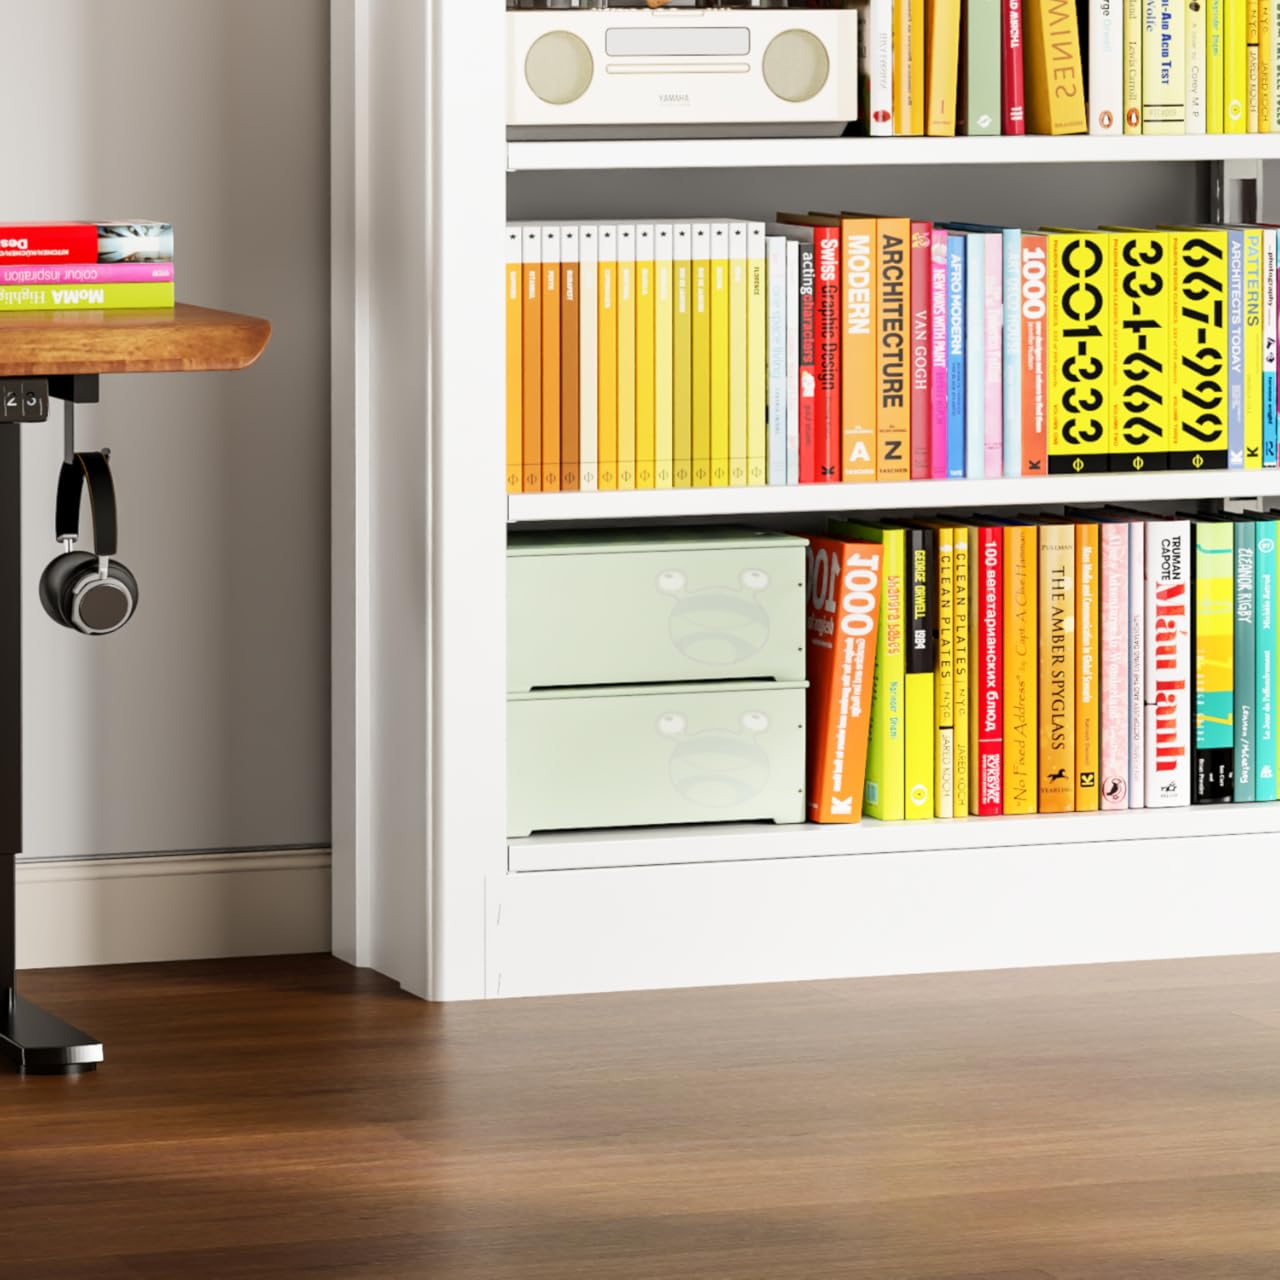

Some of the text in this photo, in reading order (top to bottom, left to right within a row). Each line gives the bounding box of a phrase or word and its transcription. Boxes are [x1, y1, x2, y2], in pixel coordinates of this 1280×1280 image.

[1128, 41, 1137, 101] Lewis Carroll
[1161, 33, 1172, 58] ACID
[1161, 61, 1172, 85] TEST
[658, 94, 690, 103] YAMAHA
[4, 268, 99, 283] colour inspiration
[51, 289, 105, 304] MoMA
[818, 238, 837, 390] Swiss Graphic Design
[848, 234, 870, 334] MODERN
[882, 234, 903, 408] ARCHITECTURE
[932, 269, 945, 368] NEW WAYS WITH PAINT
[951, 254, 961, 355] AFRO MODERN
[1023, 247, 1045, 319] 1000
[1231, 240, 1241, 373] ARCHITECTS TODAY
[1247, 235, 1259, 326] PATTERNS
[915, 310, 927, 390] VAN GOGH
[1123, 239, 1164, 446] 334-666
[1182, 238, 1223, 443] 667-999
[26, 391, 37, 406] 3
[840, 553, 879, 637] 1000
[914, 550, 926, 649] GEORGE ORWELL 1984
[1161, 538, 1171, 581] CAPOTE
[1172, 535, 1181, 580] TRUMAN
[1238, 548, 1253, 624] ELEANOR RIGBY
[941, 555, 950, 679] CLEAN PLATES
[956, 553, 966, 676] CLEAN PLATES
[984, 541, 998, 731] 100 вегетарианских блюд
[1051, 565, 1065, 750] THE AMBER SPYGLASS
[1152, 581, 1188, 773] Máu lạnh
[942, 734, 951, 798] JARED KOCH
